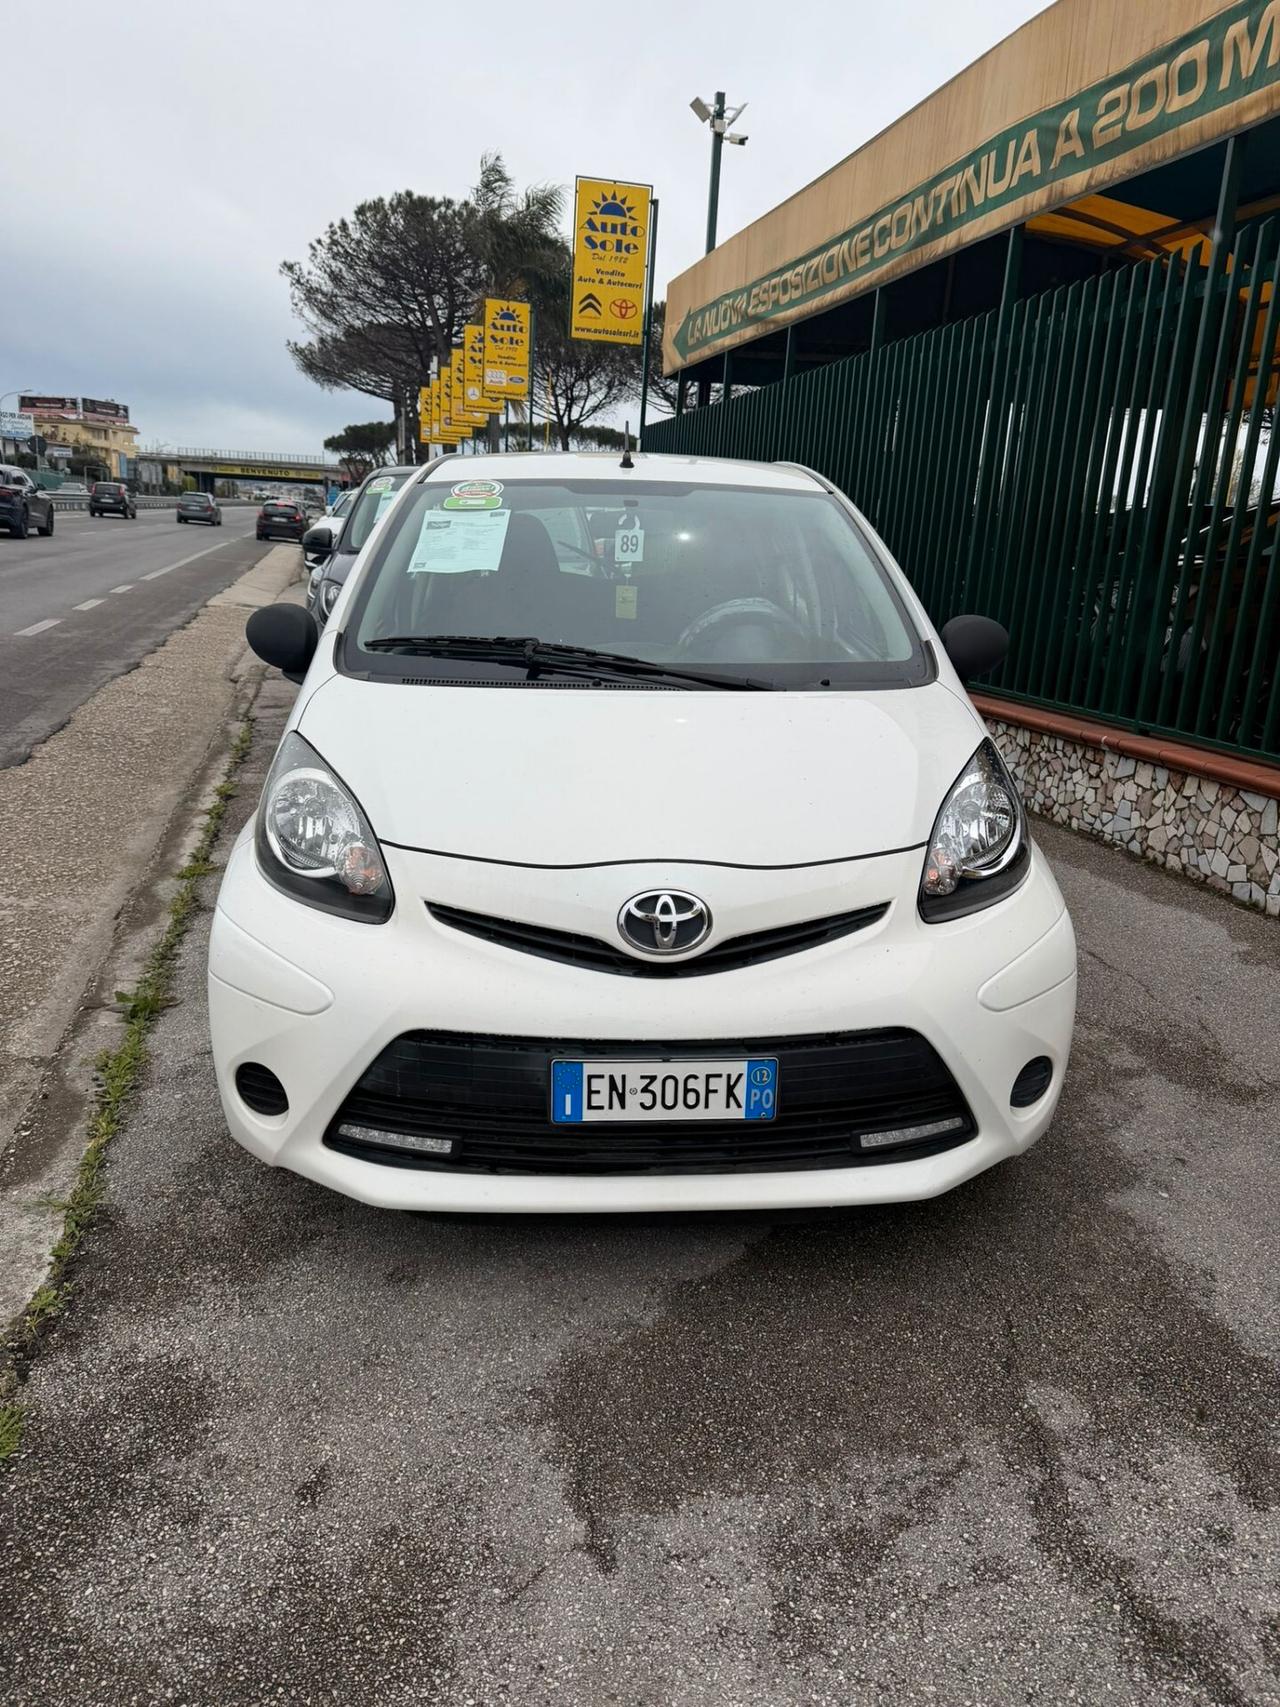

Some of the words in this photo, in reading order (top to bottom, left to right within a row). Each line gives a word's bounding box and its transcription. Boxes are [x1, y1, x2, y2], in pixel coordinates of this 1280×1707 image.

[687, 319, 702, 346] LA
[702, 292, 748, 337] NUOVA
[1050, 107, 1085, 170] A
[1092, 38, 1210, 150] 200
[579, 217, 646, 237] Auto
[584, 235, 639, 255] Sole
[240, 467, 290, 476] BENVENUTO
[620, 534, 638, 553] 89
[755, 1071, 768, 1082] 12
[750, 1089, 773, 1109] PO
